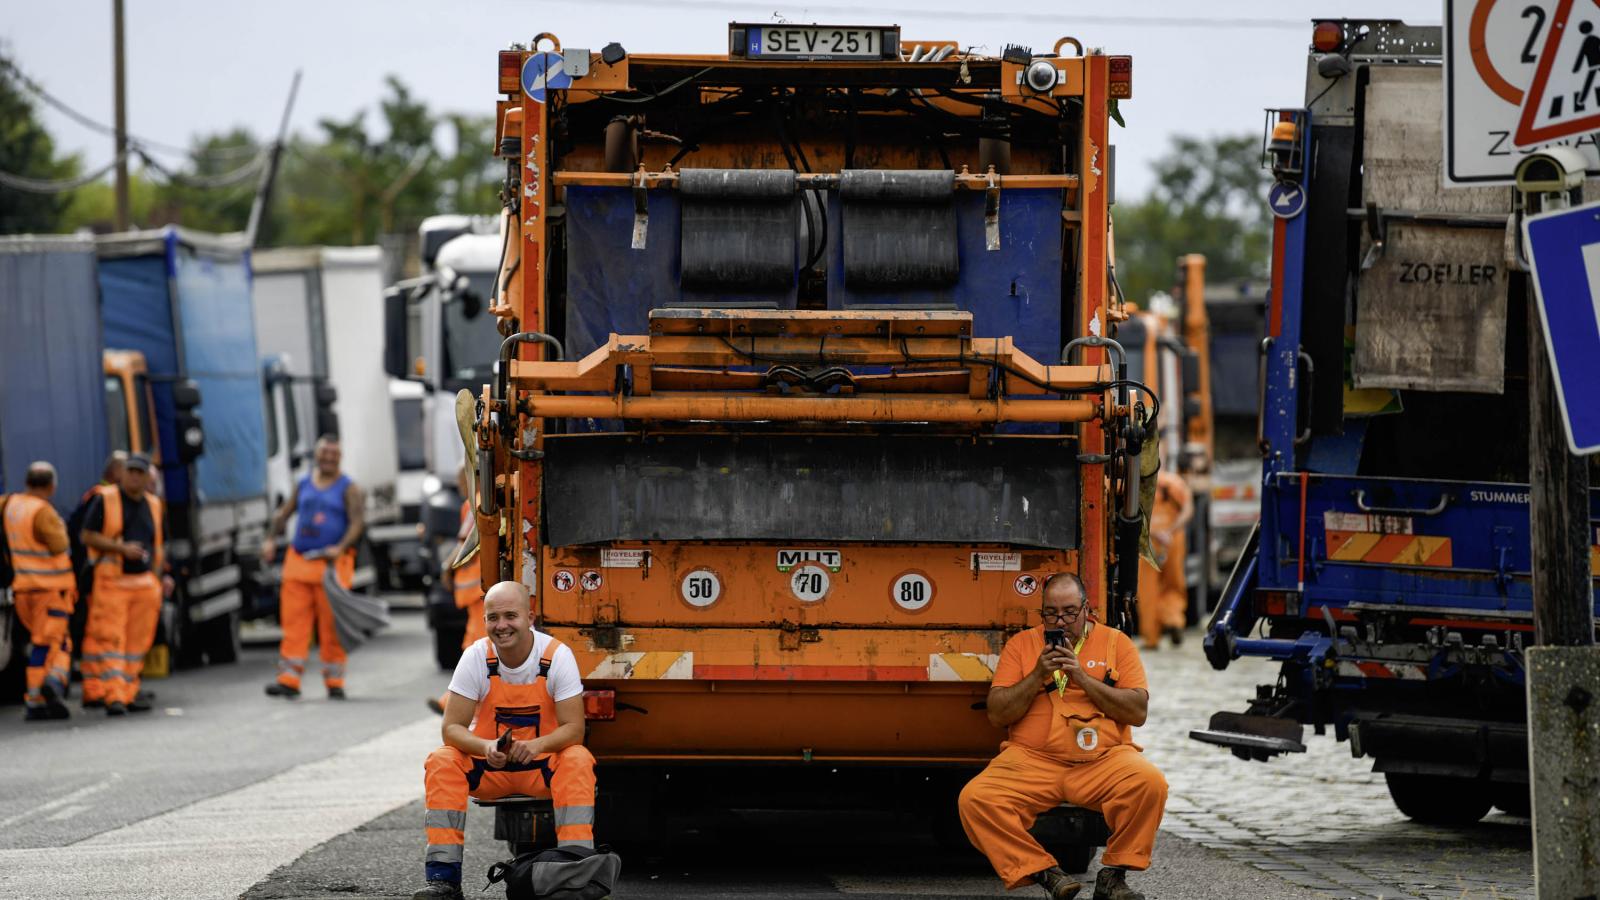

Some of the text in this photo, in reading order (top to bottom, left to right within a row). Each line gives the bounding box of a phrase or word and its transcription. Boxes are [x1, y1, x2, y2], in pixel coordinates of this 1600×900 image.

[767, 30, 873, 53] SEV-251
[1399, 262, 1497, 286] ZOELLER
[780, 552, 838, 565] MUT
[689, 577, 713, 598] 50
[799, 573, 822, 594] 70
[900, 580, 924, 602] 80
